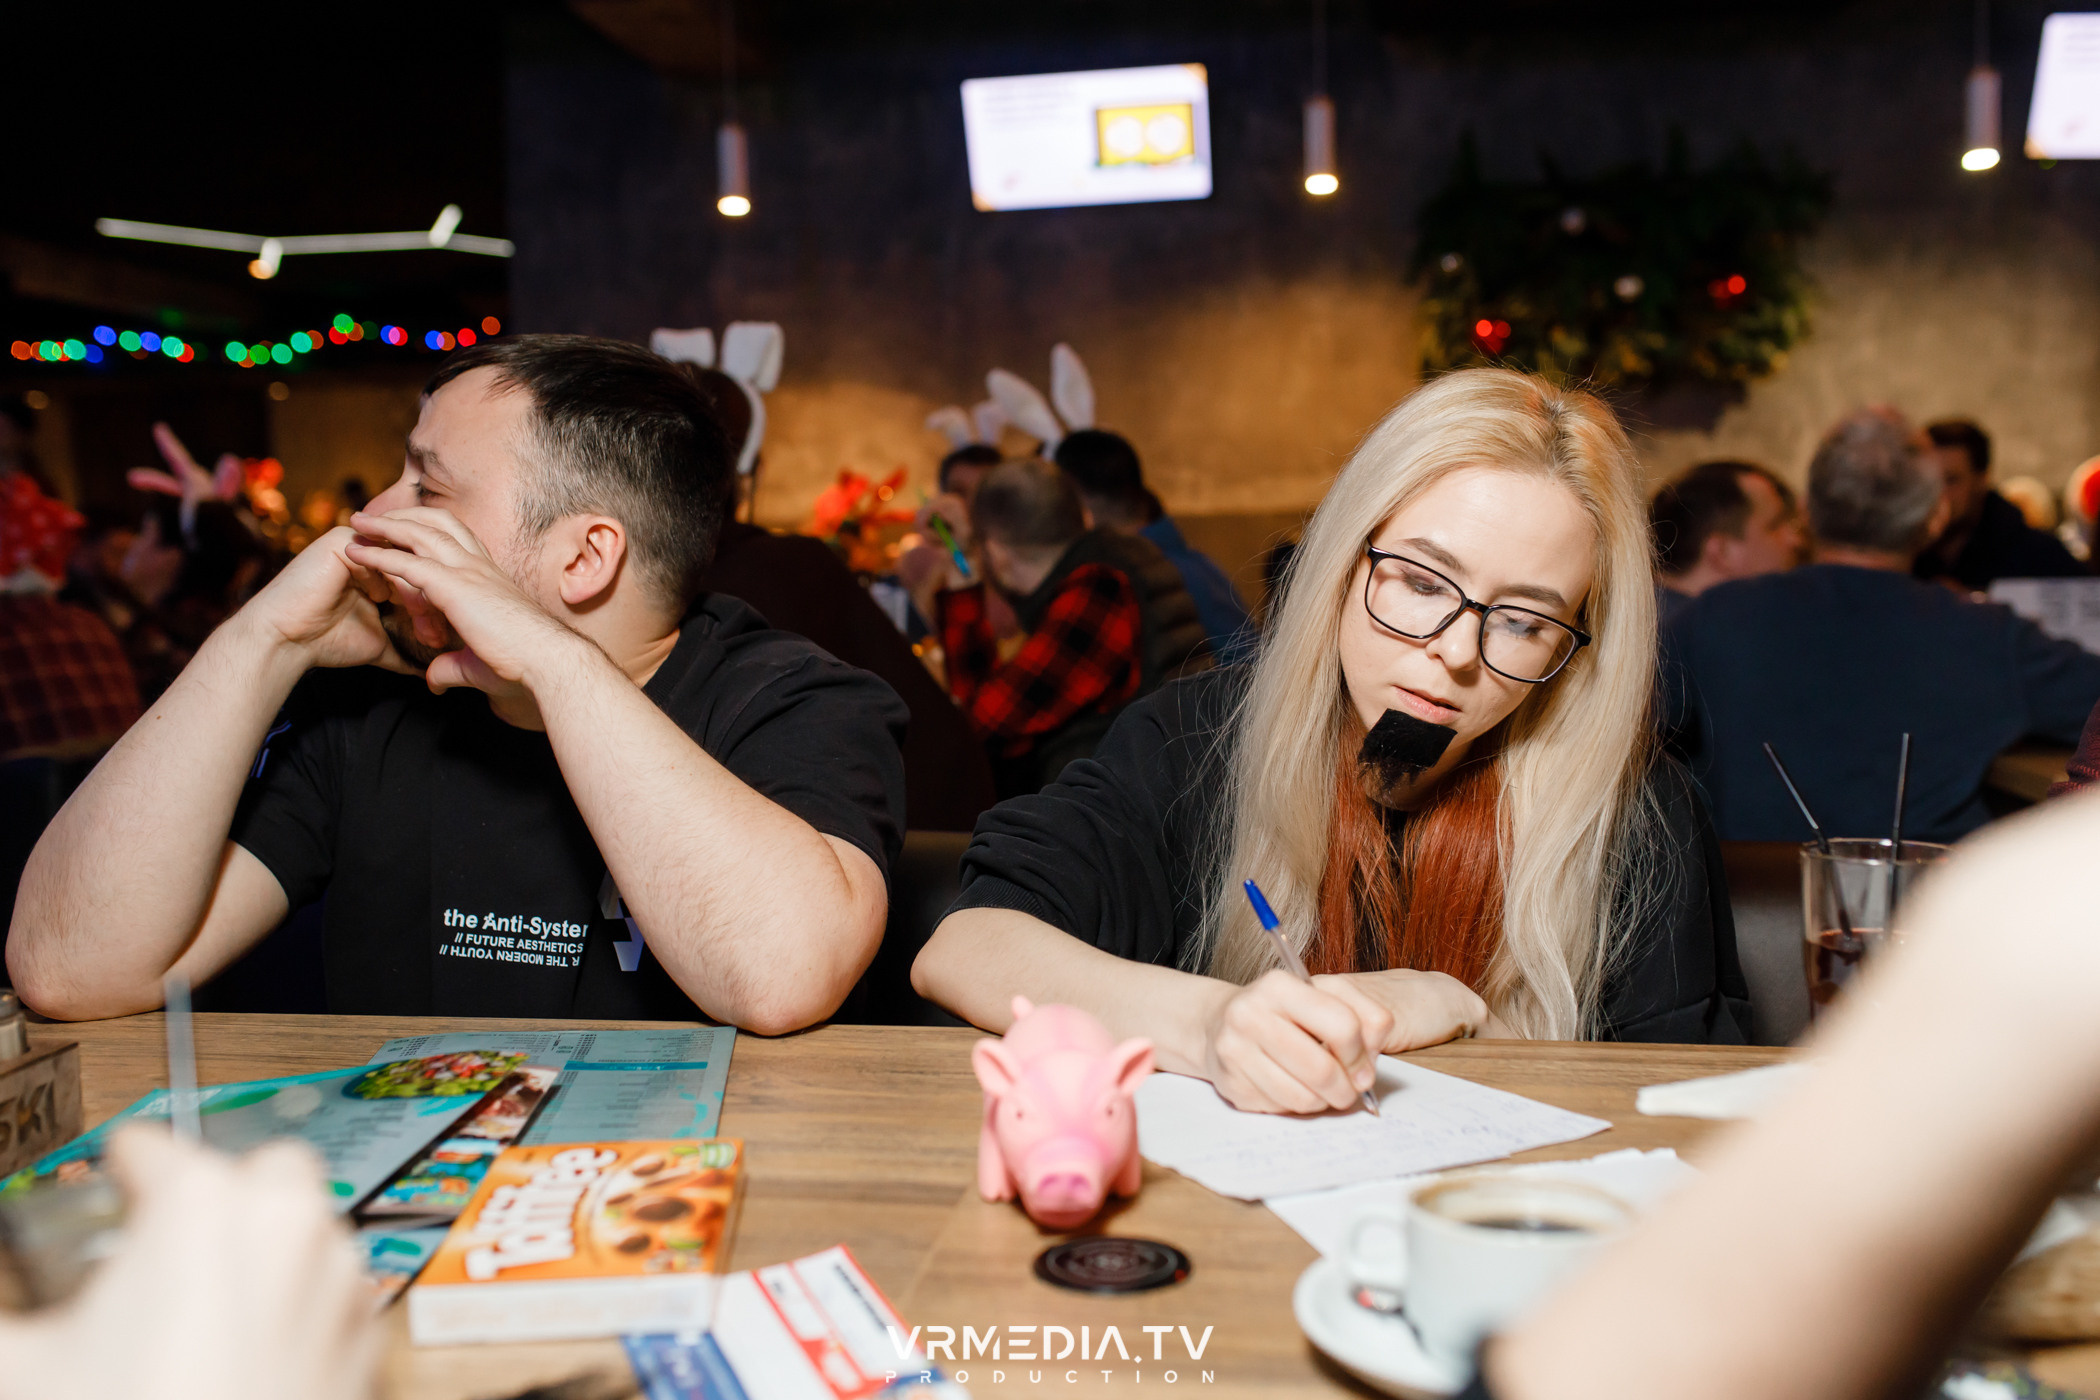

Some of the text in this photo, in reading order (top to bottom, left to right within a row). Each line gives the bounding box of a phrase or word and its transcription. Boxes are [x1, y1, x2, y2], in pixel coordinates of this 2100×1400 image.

[443, 908, 478, 928] the
[465, 933, 515, 948] FUTURE
[516, 939, 584, 954] AESTHETICS
[450, 945, 494, 960] YOUTH
[496, 950, 544, 965] MODERN
[546, 955, 568, 967] THE
